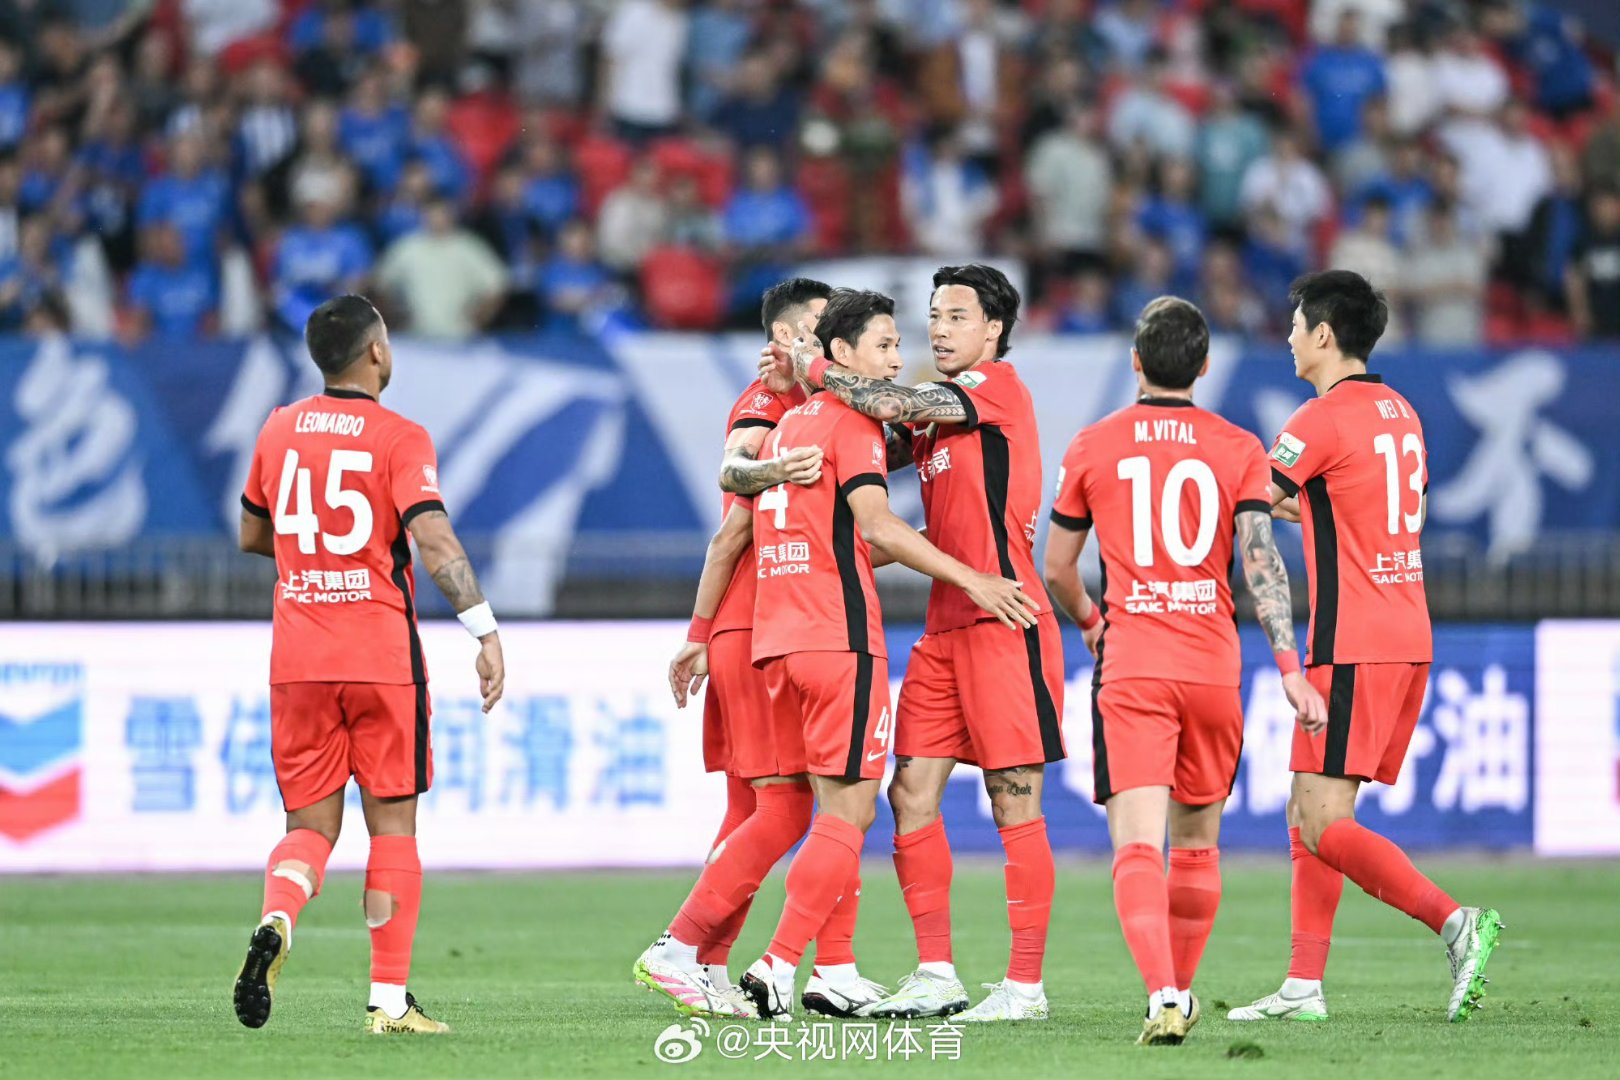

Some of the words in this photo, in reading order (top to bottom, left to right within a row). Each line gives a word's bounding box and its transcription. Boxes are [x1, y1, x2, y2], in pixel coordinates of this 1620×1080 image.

[1374, 399, 1399, 420] WEI
[295, 411, 365, 437] LEONARDO
[1134, 419, 1197, 444] M.VITAL
[1373, 432, 1424, 535] 13
[274, 448, 373, 556] 45
[1117, 456, 1220, 567] 10
[281, 568, 371, 591] 上汽集团
[1125, 579, 1217, 602] 上汽集团
[1371, 573, 1404, 584] SAIC
[313, 590, 372, 603] MOTOR
[1125, 602, 1165, 614] SAIC
[873, 705, 890, 748] 4
